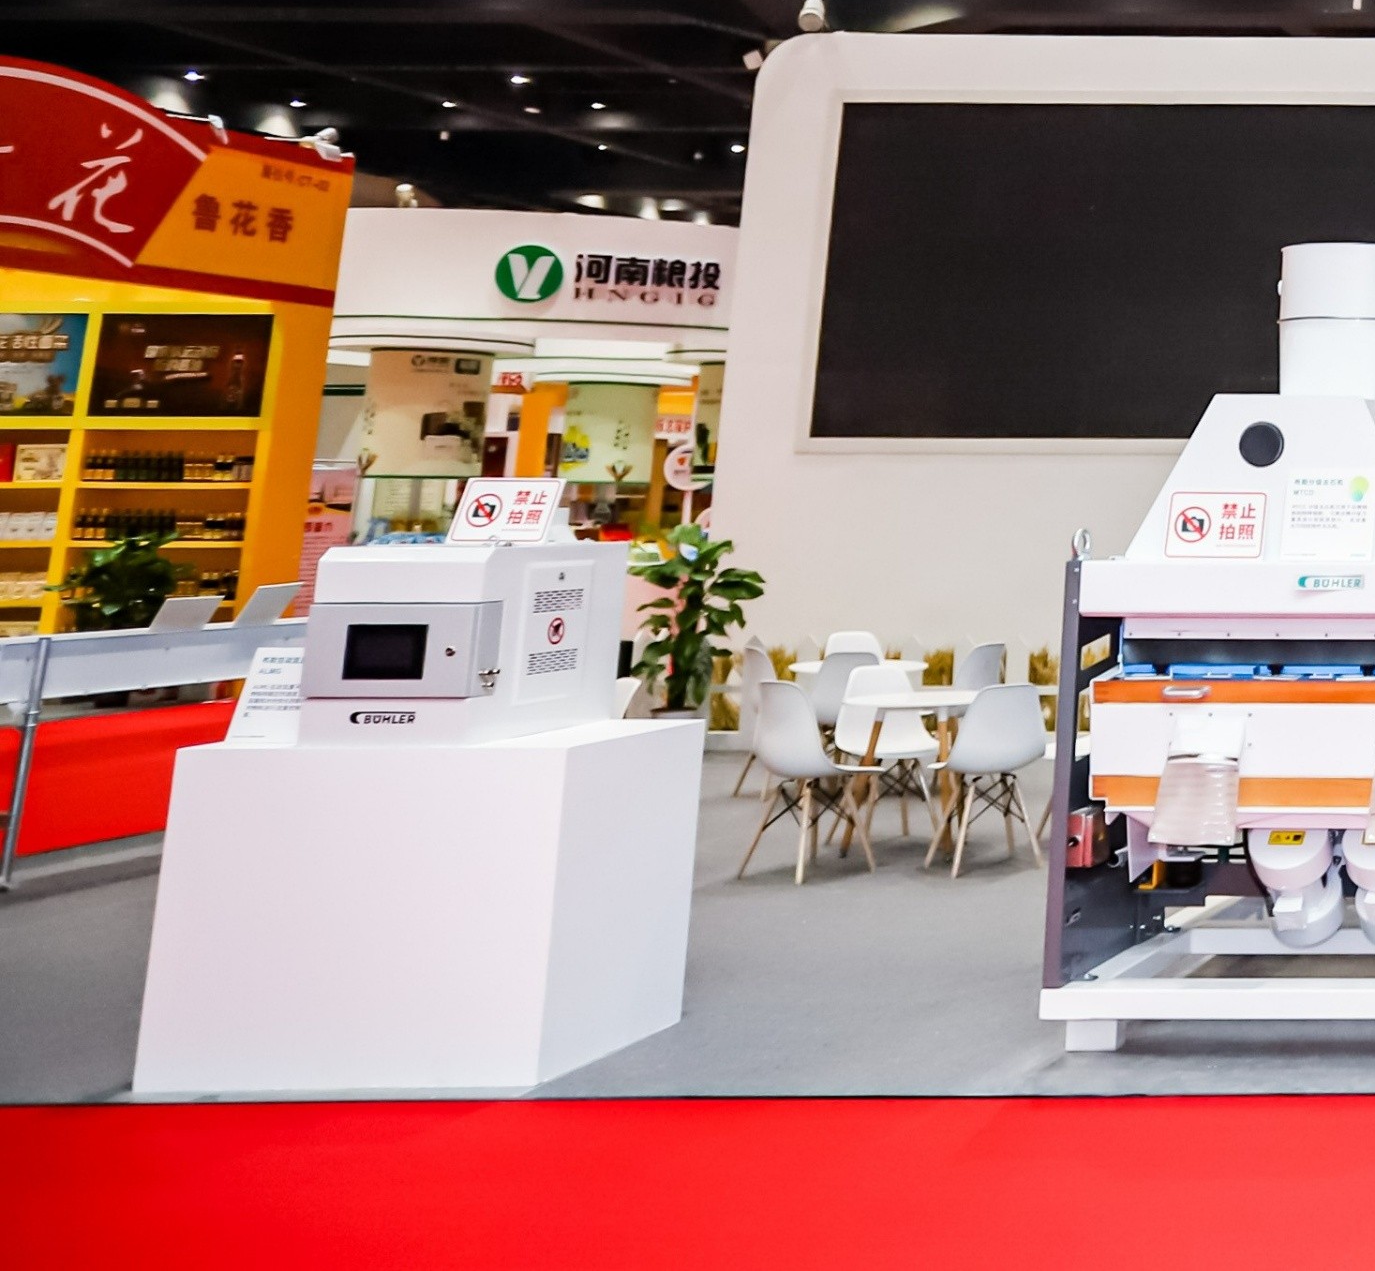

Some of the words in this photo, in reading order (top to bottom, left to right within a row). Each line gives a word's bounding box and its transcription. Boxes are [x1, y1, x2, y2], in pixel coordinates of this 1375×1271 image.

[192, 193, 294, 243] 鲁花香
[575, 254, 721, 291] 河南粮投
[513, 490, 548, 505] 禁止
[506, 510, 543, 524] 拍照
[1221, 503, 1257, 520] 禁止
[1219, 524, 1254, 540] 拍照
[1313, 578, 1362, 588] BÜHLER
[363, 714, 416, 724] BÜHLER
